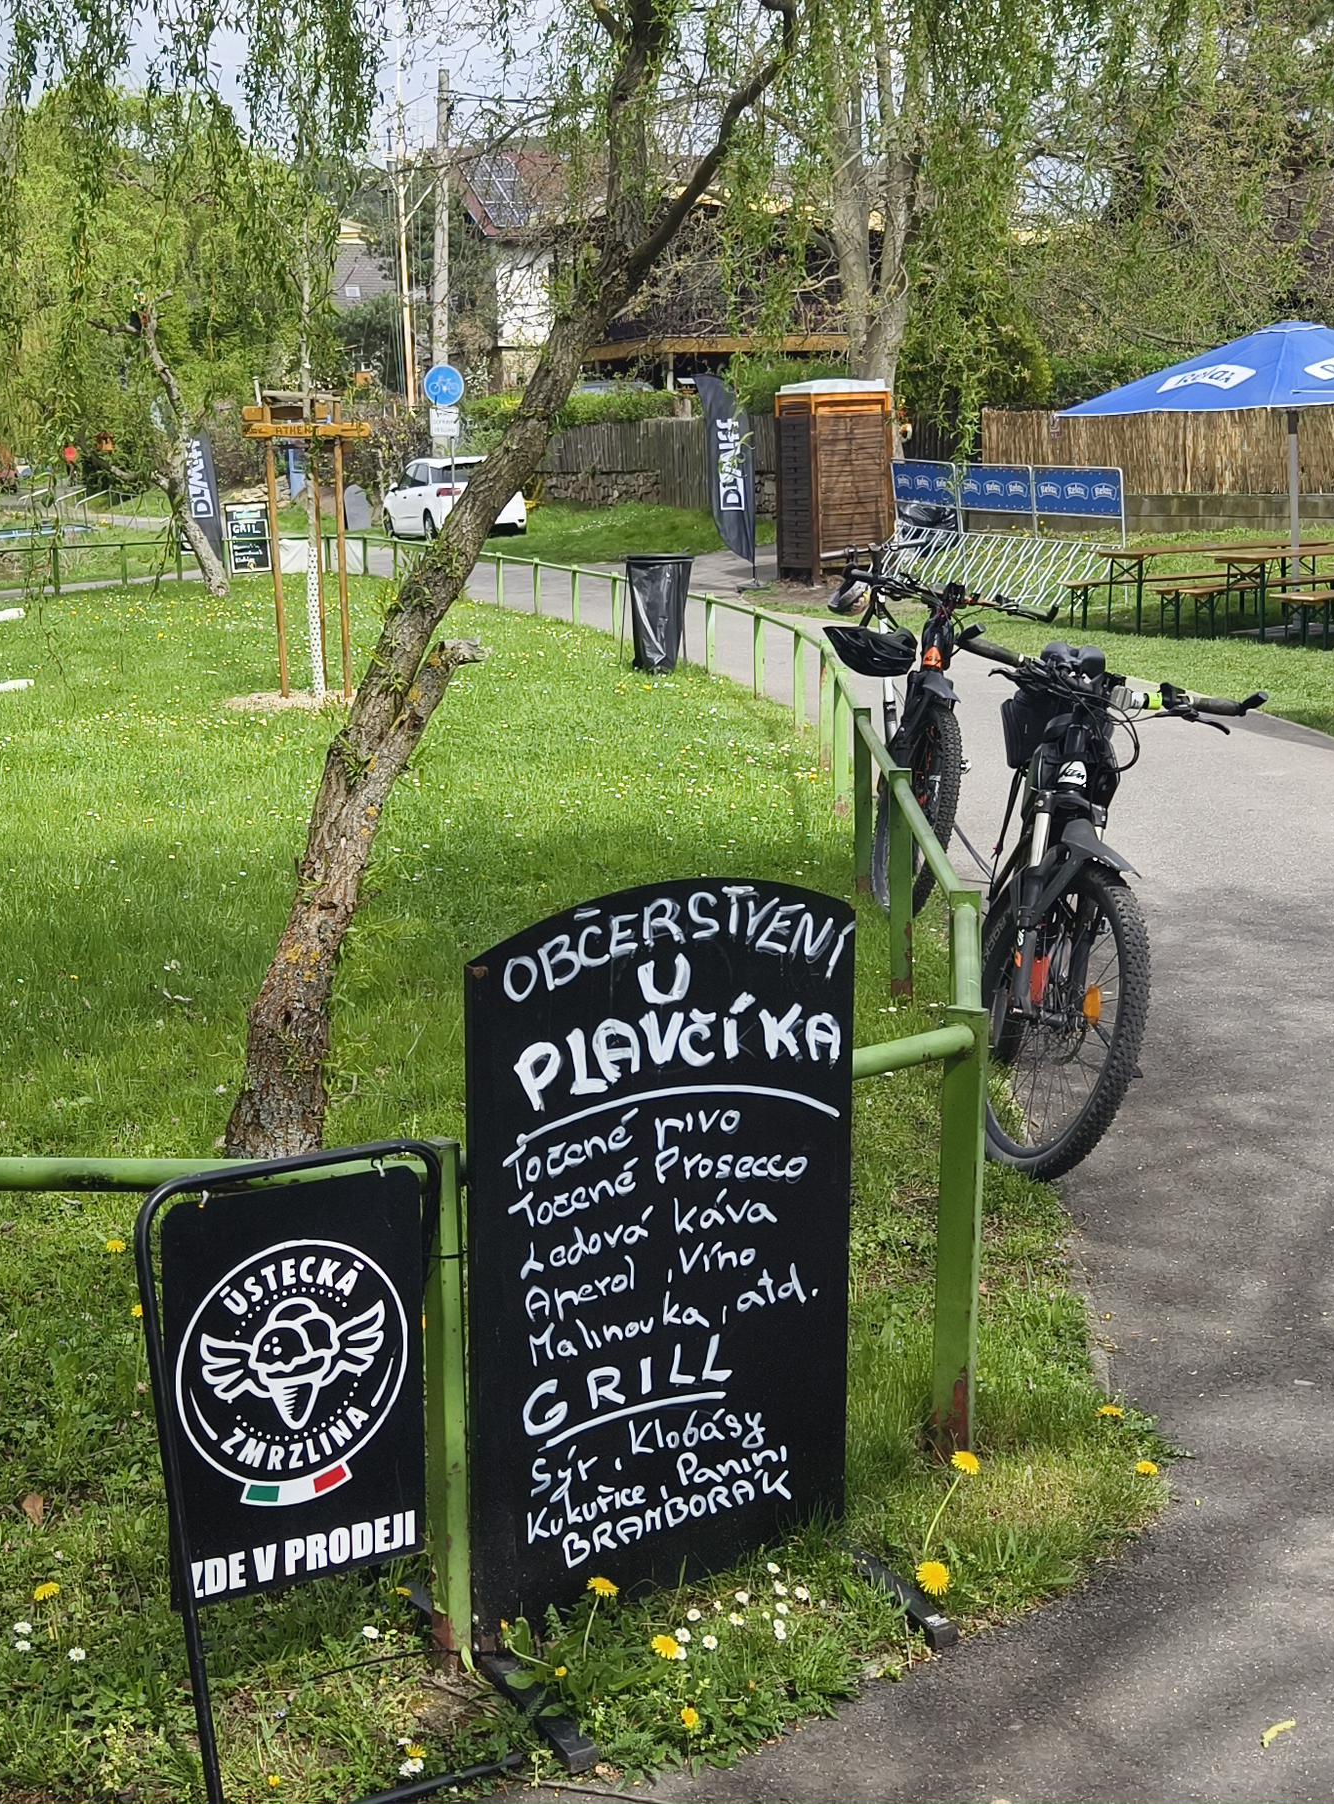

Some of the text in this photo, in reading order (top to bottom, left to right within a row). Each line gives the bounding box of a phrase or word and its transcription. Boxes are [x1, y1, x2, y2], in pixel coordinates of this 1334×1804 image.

[503, 885, 855, 1002] OBČERSTVENÍ
[637, 952, 691, 1004] U
[654, 1145, 808, 1184] Prosecco
[520, 1205, 654, 1280] Ledová
[219, 1255, 365, 1316] ÚSTECKÁ
[522, 1333, 733, 1437] GRILL
[220, 1406, 370, 1472] ZMRZLINA
[676, 1445, 788, 1487] Panini
[252, 1543, 278, 1583] V
[284, 1509, 417, 1576] PRODEJI
[561, 1468, 792, 1569] BRAMBORÁK
